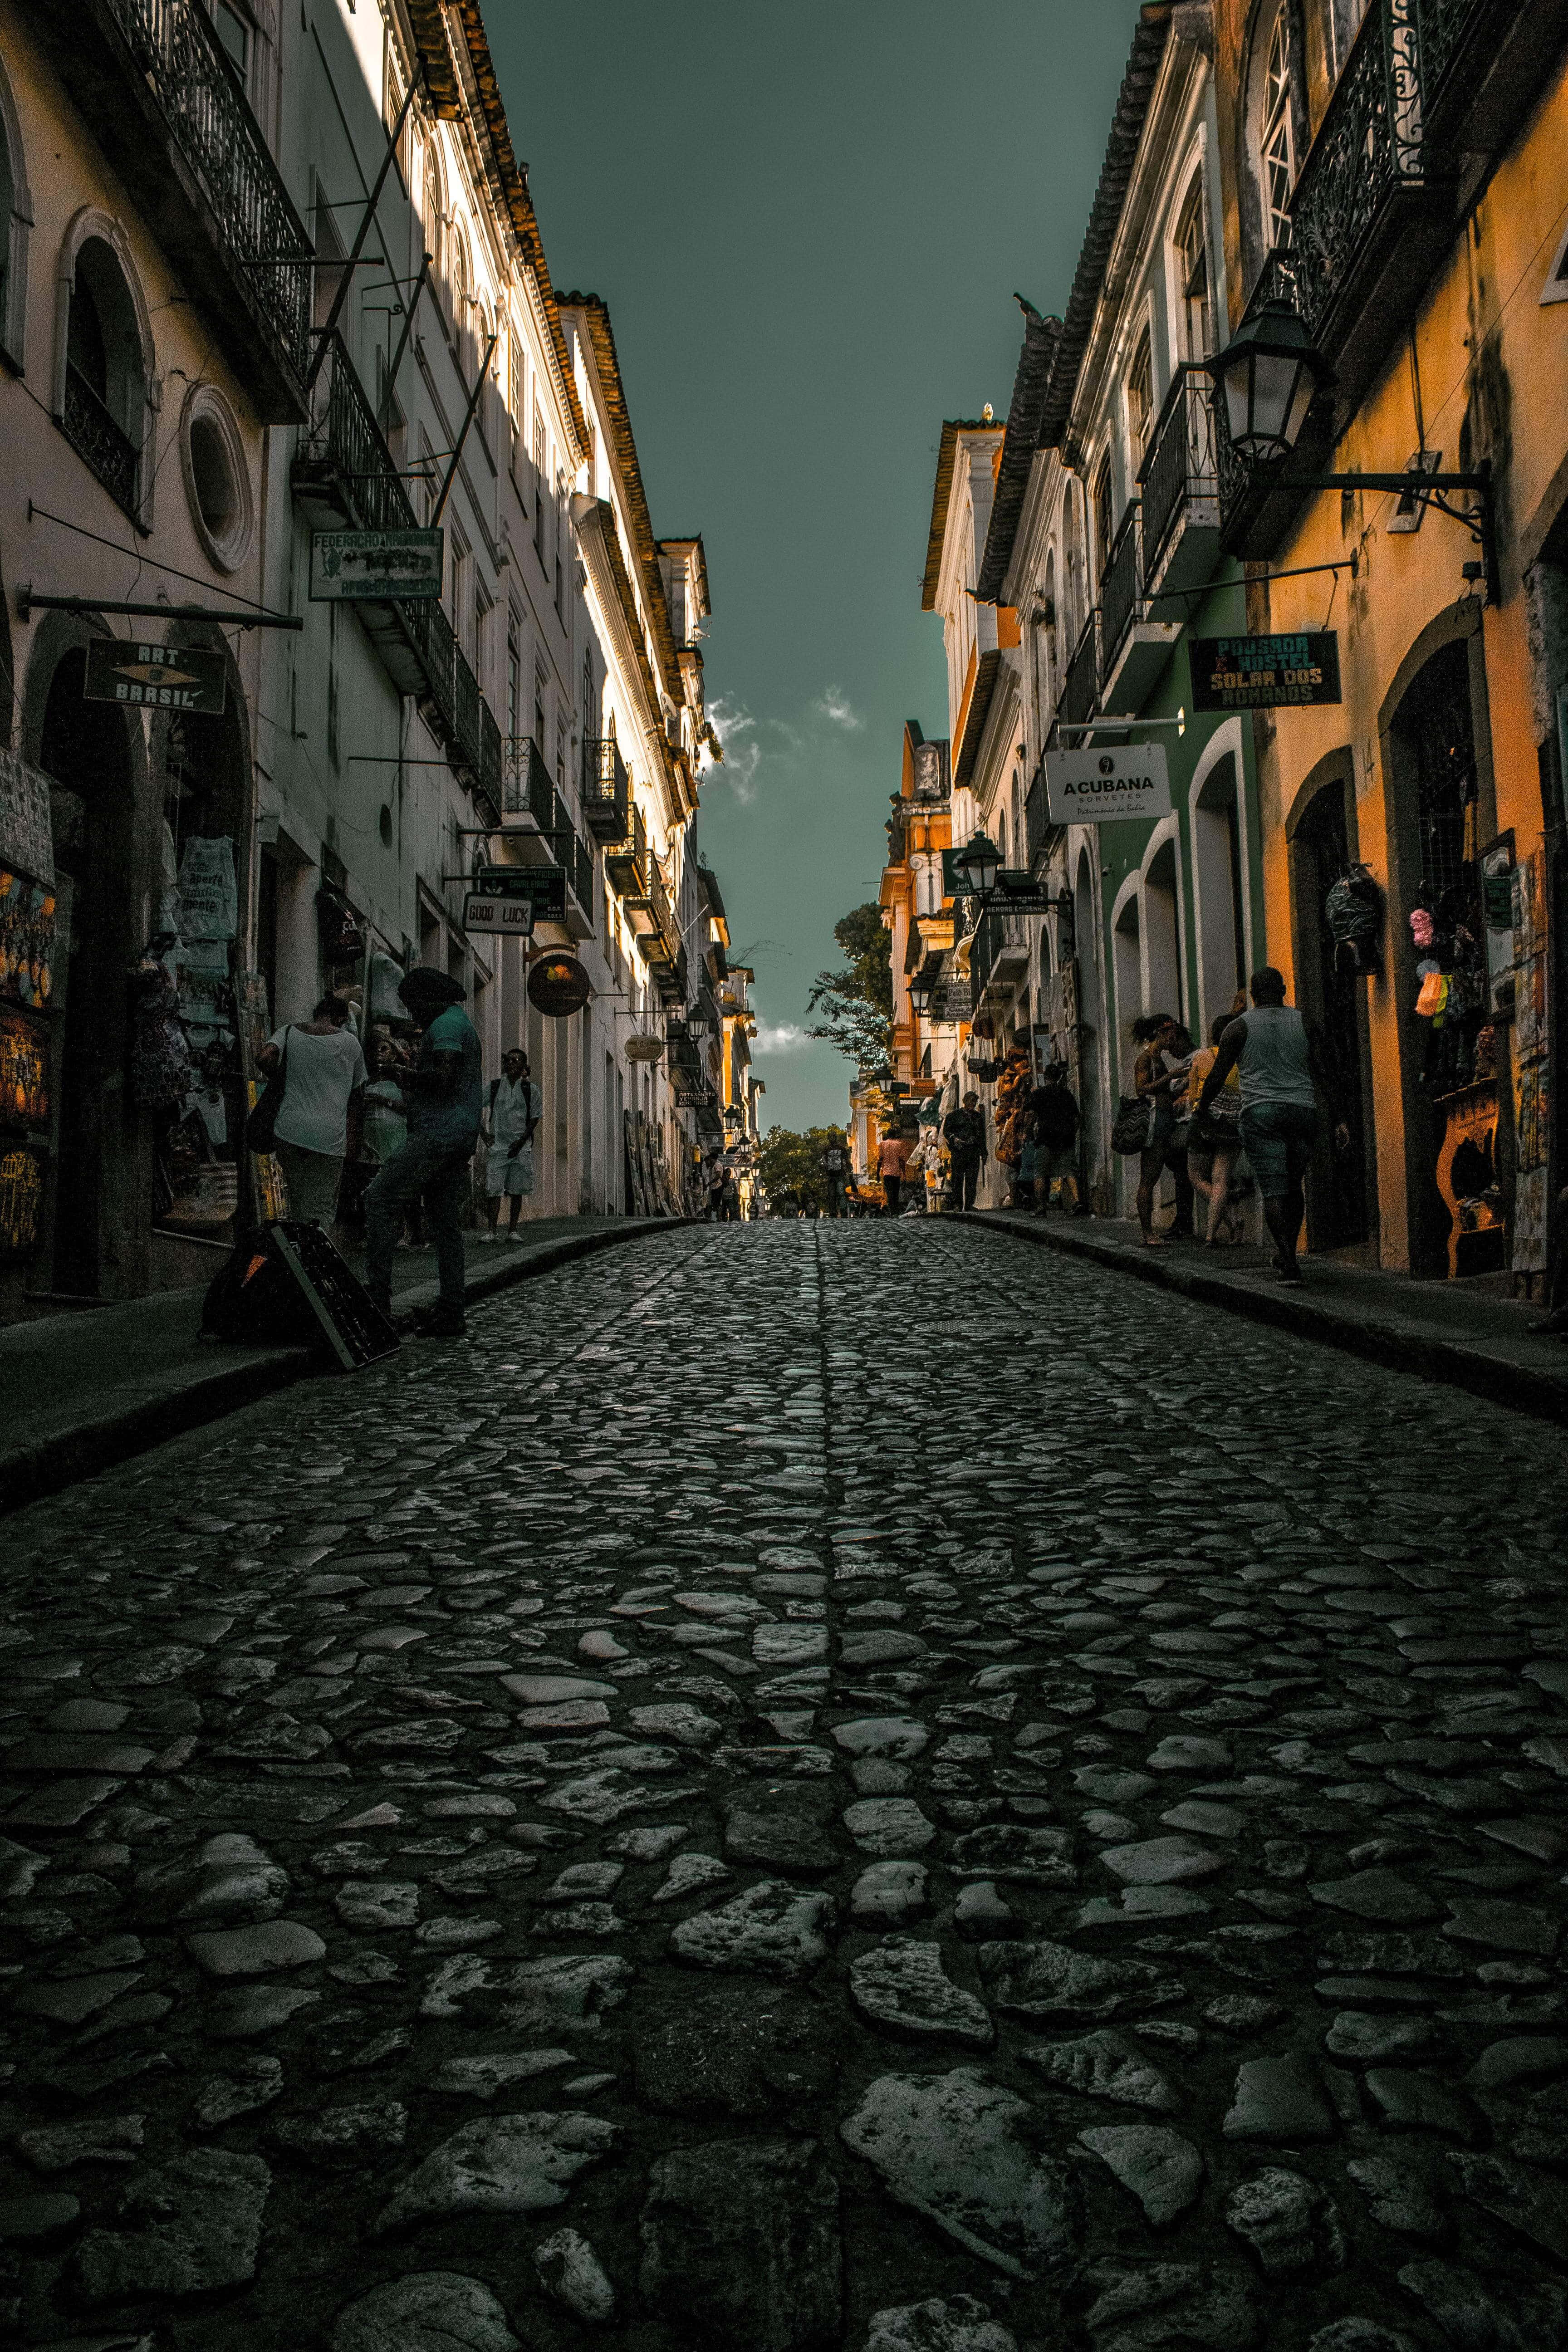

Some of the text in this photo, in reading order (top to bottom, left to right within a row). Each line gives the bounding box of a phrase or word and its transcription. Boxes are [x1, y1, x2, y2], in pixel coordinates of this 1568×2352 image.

[138, 646, 178, 665] ART
[1217, 637, 1308, 656] POUSADA
[1238, 653, 1315, 671] HOSTEL
[1210, 667, 1322, 690] SOLAR DOS
[116, 683, 194, 707] BRASIL
[1221, 685, 1315, 704] ROMANOS
[1079, 794, 1141, 803] SORVETES
[1127, 804, 1145, 812] Bahia
[469, 905, 494, 921] GOOD
[503, 906, 528, 923] LUCK
